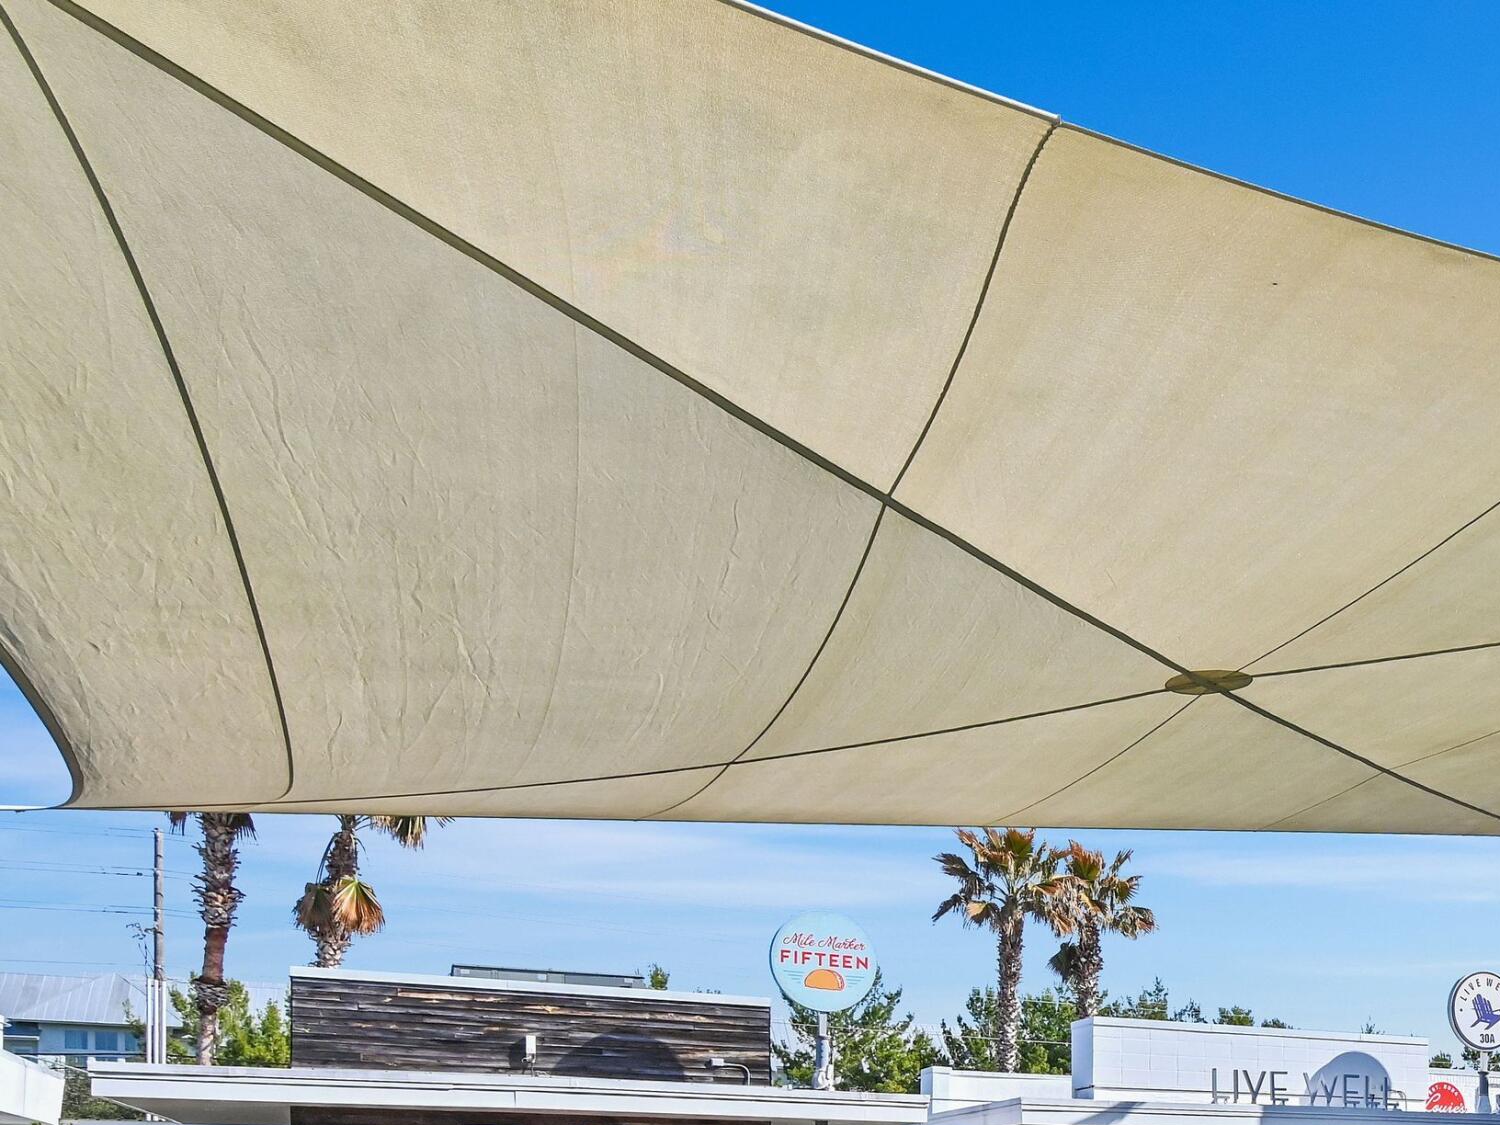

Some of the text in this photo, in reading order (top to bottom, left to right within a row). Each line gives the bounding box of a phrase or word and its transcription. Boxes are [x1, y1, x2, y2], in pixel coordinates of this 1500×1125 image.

[782, 932, 866, 952] Mile Marker
[780, 949, 869, 970] FIFTEEN
[1460, 978, 1482, 1002] LIVE
[1479, 1033, 1495, 1044] 30A
[1211, 1067, 1400, 1110] LIVE WELL
